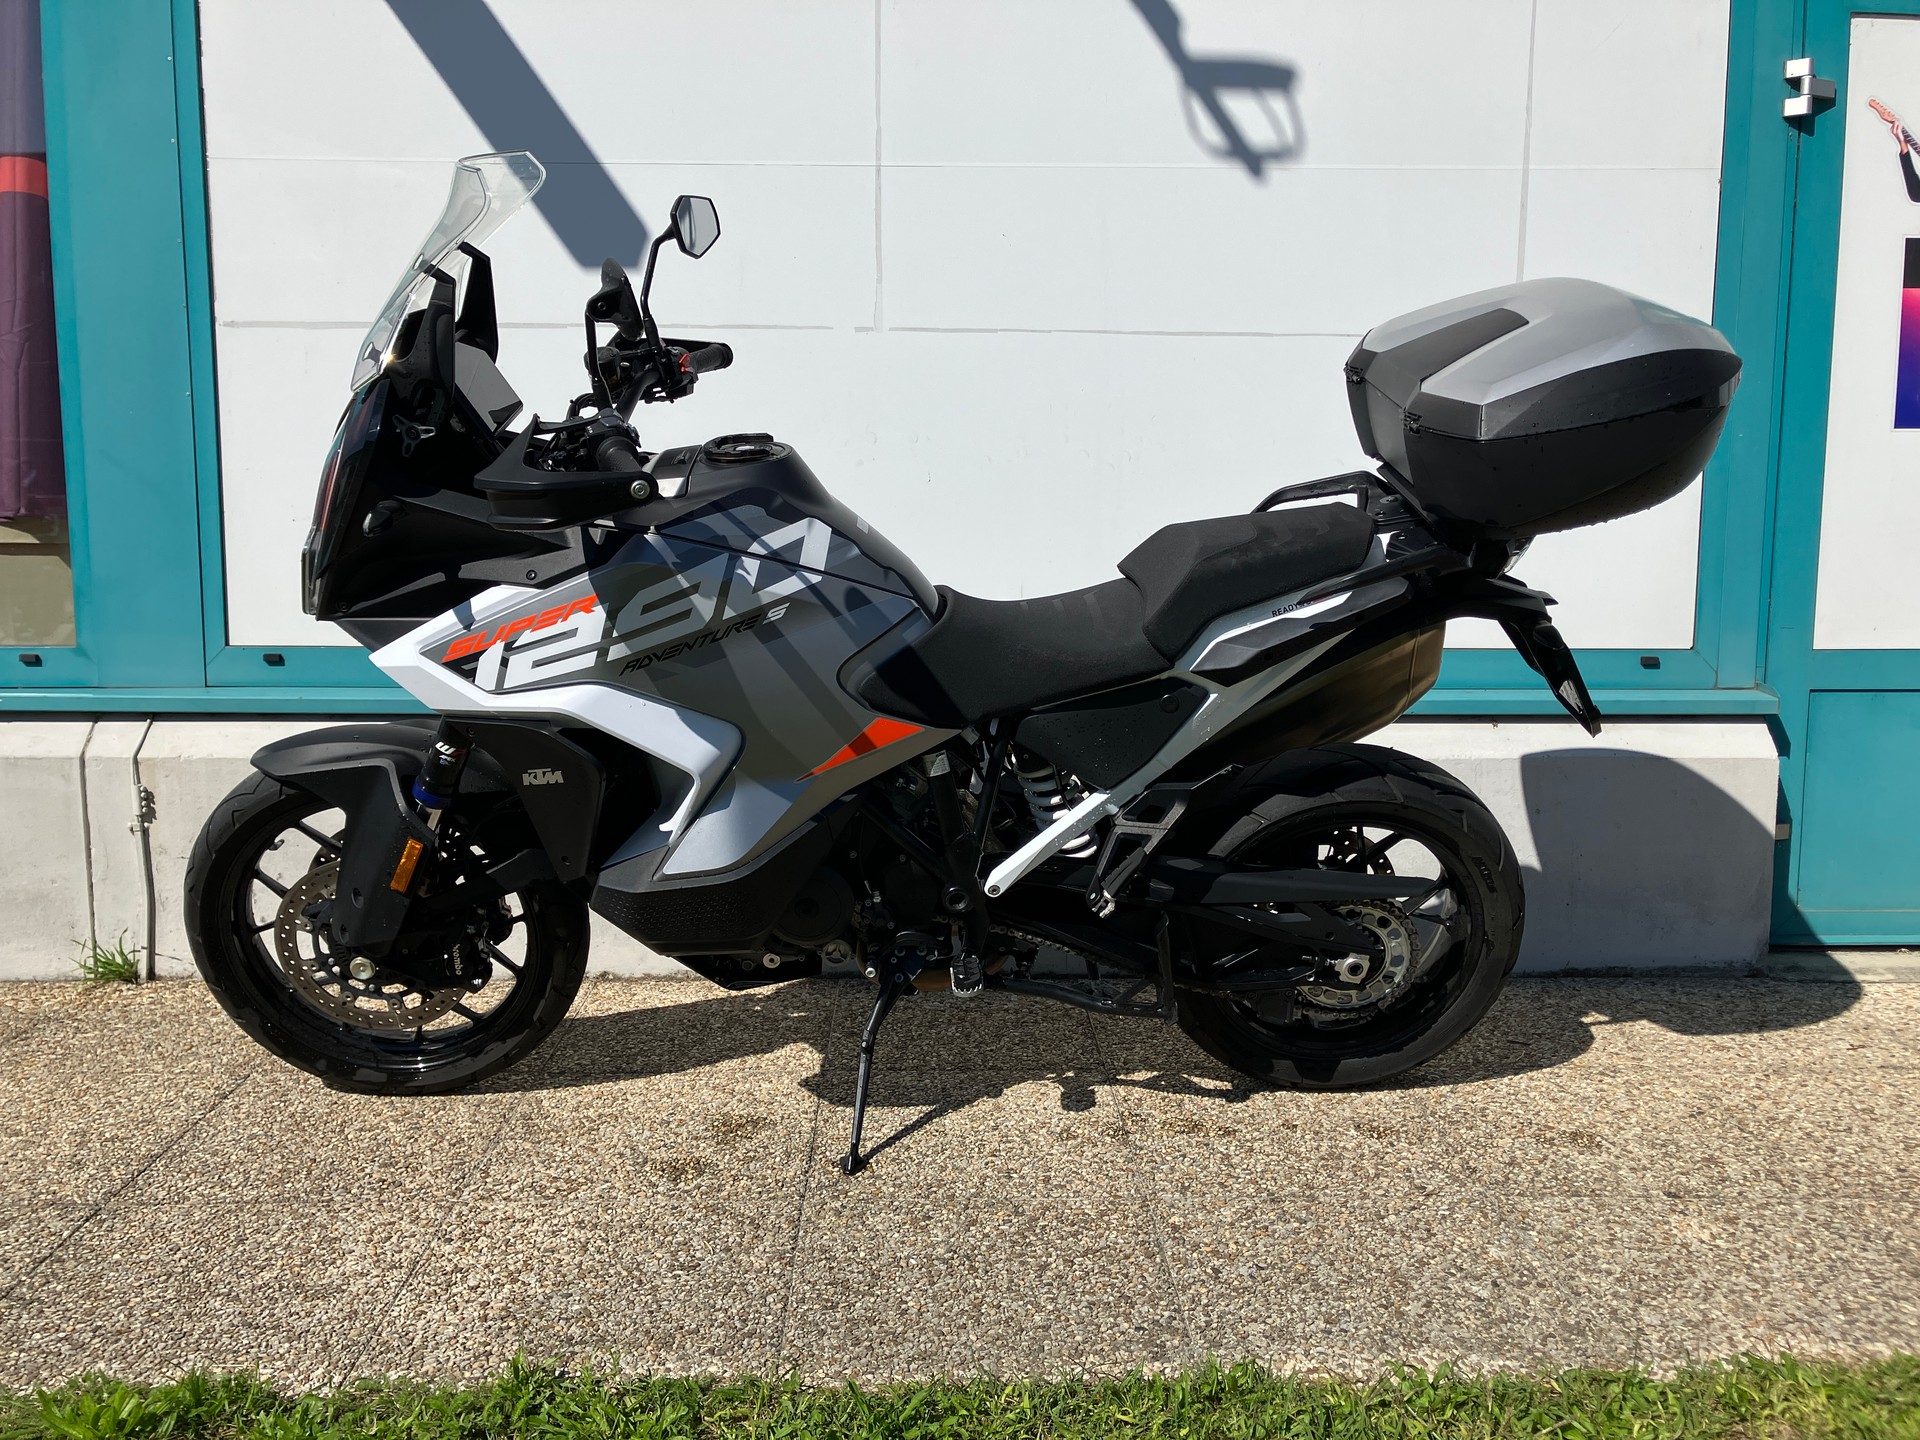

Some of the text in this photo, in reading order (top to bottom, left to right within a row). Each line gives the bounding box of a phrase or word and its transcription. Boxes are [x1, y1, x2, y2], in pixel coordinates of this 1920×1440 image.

[442, 593, 599, 663] SUPER
[461, 517, 832, 691] 1290
[1271, 603, 1299, 617] READY
[619, 602, 791, 677] ADVENTURE S
[522, 768, 564, 786] KTM
